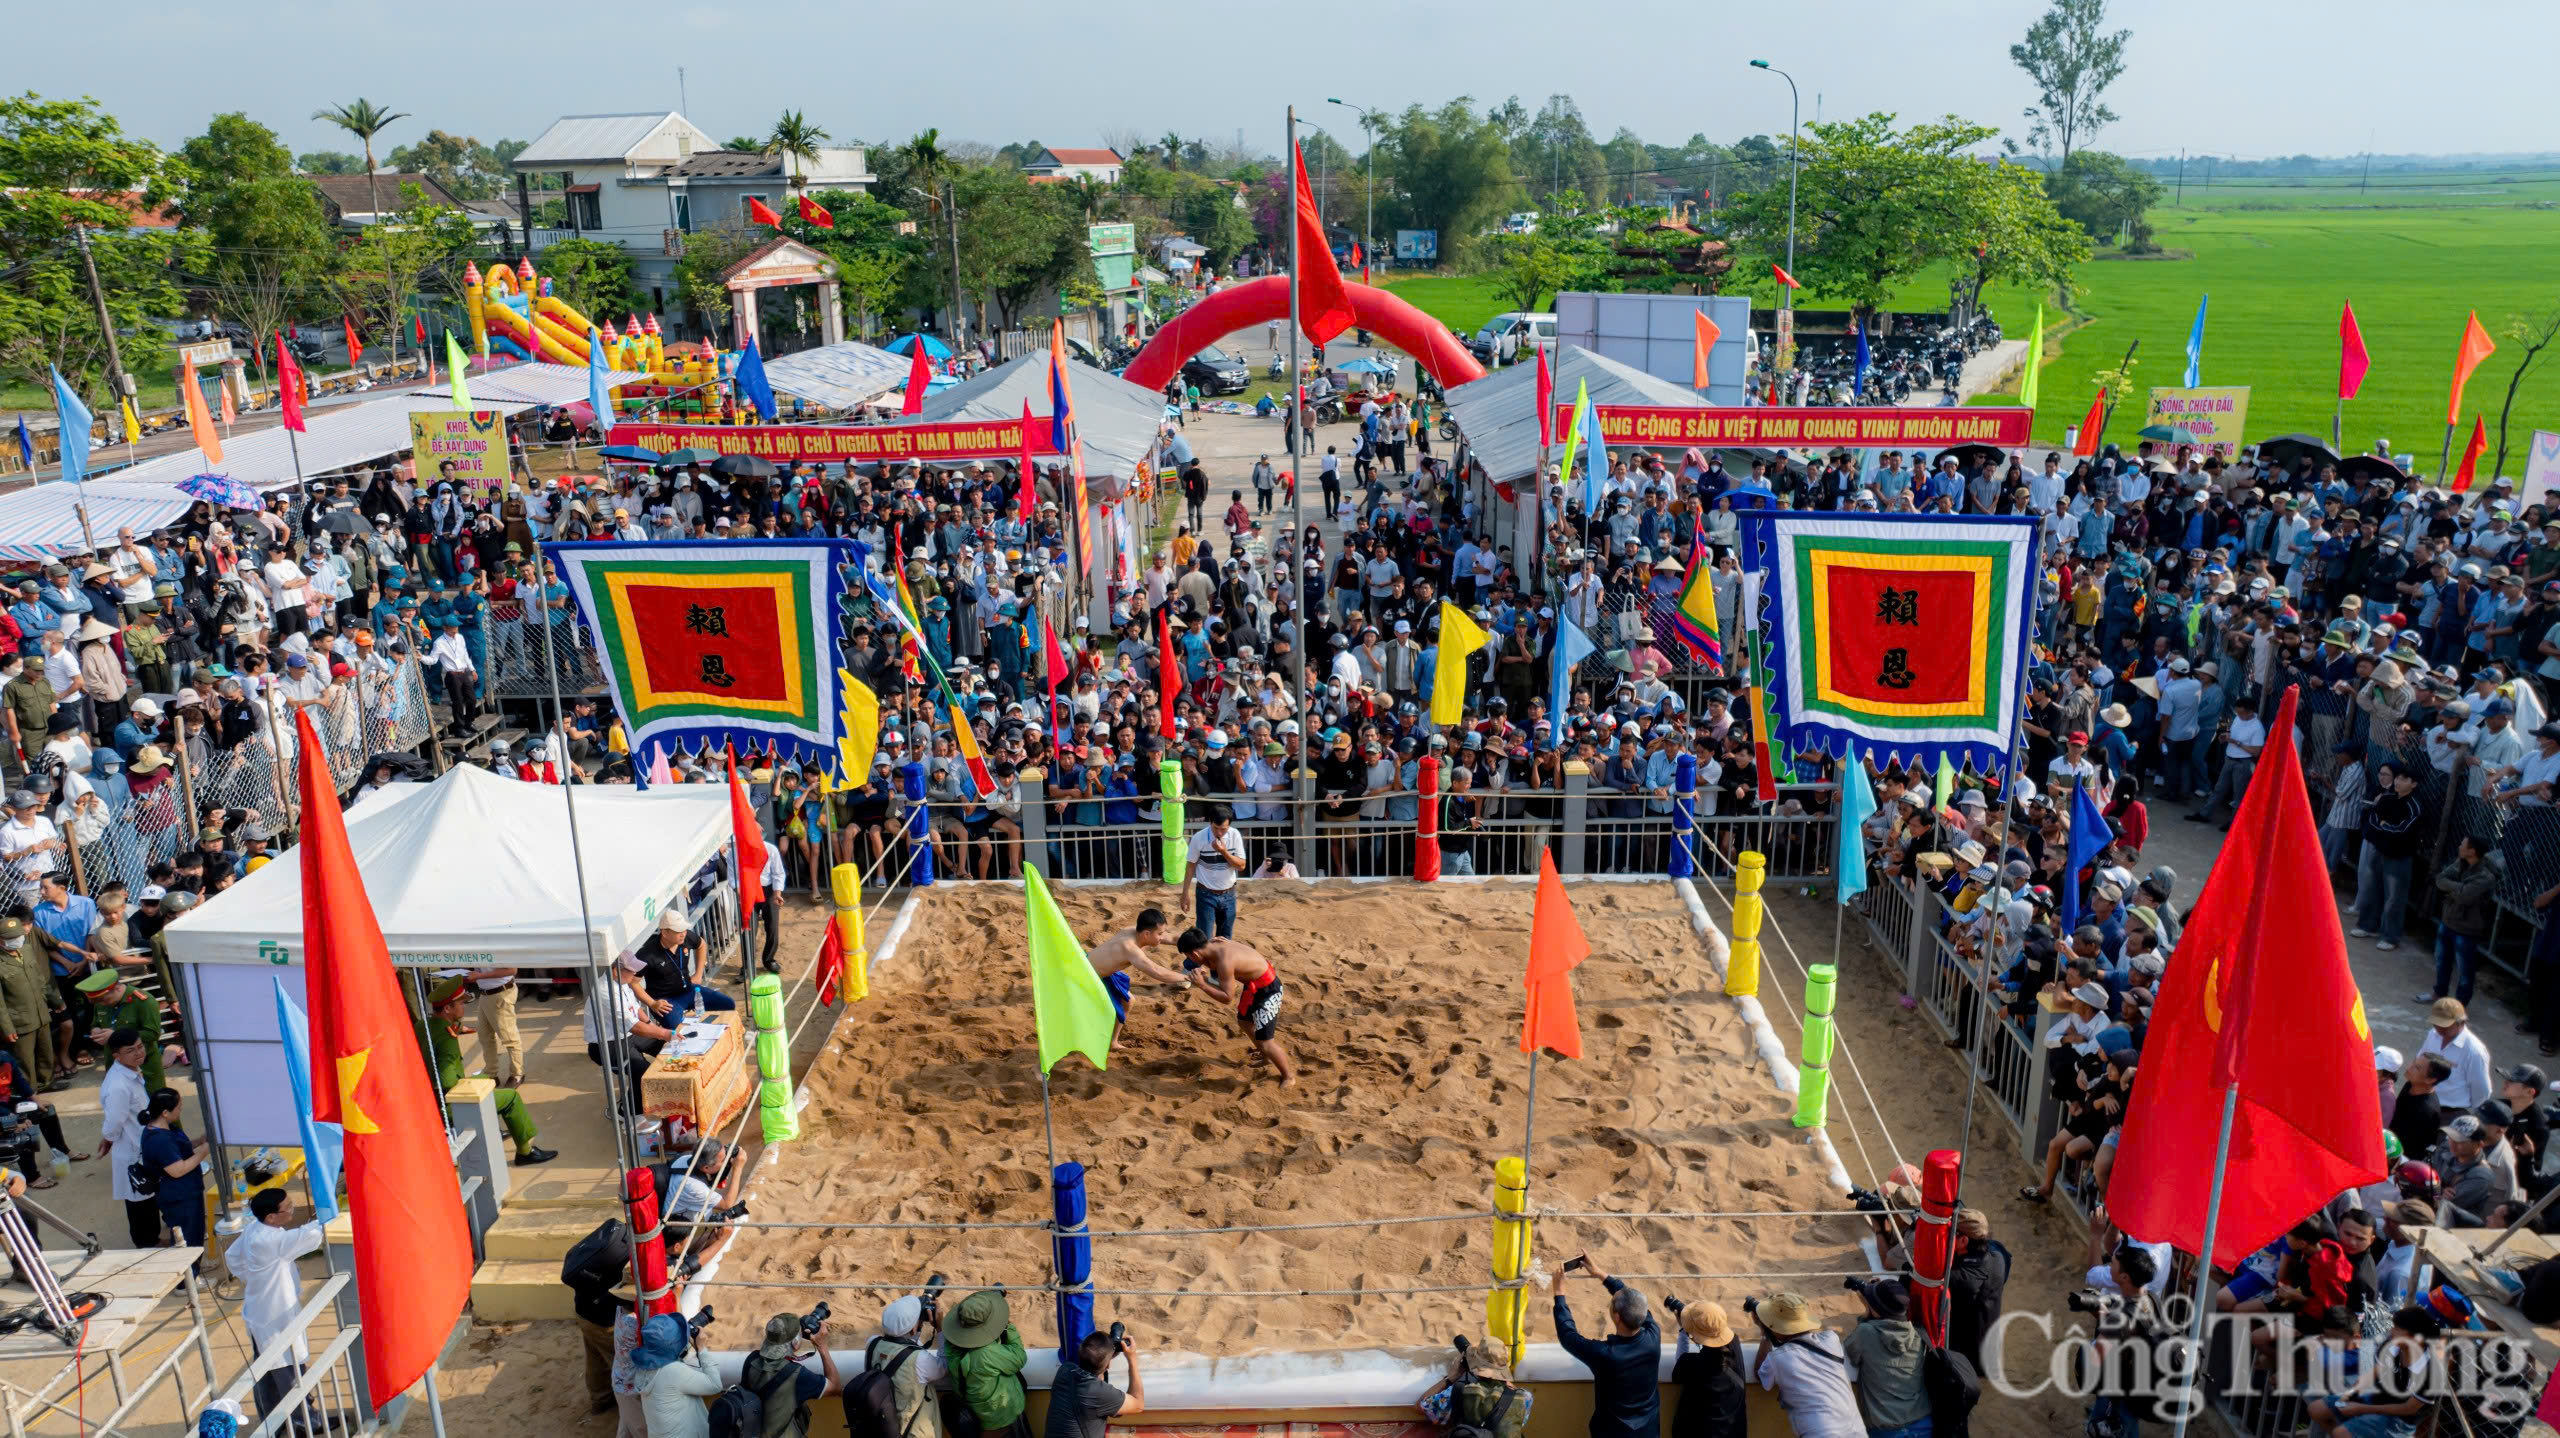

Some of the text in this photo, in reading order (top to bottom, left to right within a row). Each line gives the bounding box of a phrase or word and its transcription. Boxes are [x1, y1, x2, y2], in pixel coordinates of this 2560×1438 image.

[638, 431, 677, 453] NƯỚC
[722, 431, 750, 454] HÒA
[753, 432, 773, 454] XÃ
[776, 432, 799, 458] HỘI
[804, 430, 833, 454] CHỦ
[835, 432, 880, 453] NGHĨA
[882, 431, 912, 456] VIỆT
[916, 432, 950, 451] NAM
[953, 427, 997, 450] MUÔN
[1000, 426, 1023, 448] NĂ
[1599, 411, 2000, 442] ẢNG CỘNG SẢN VIỆT NAM QUANG VINH MUÔN NĂM!
